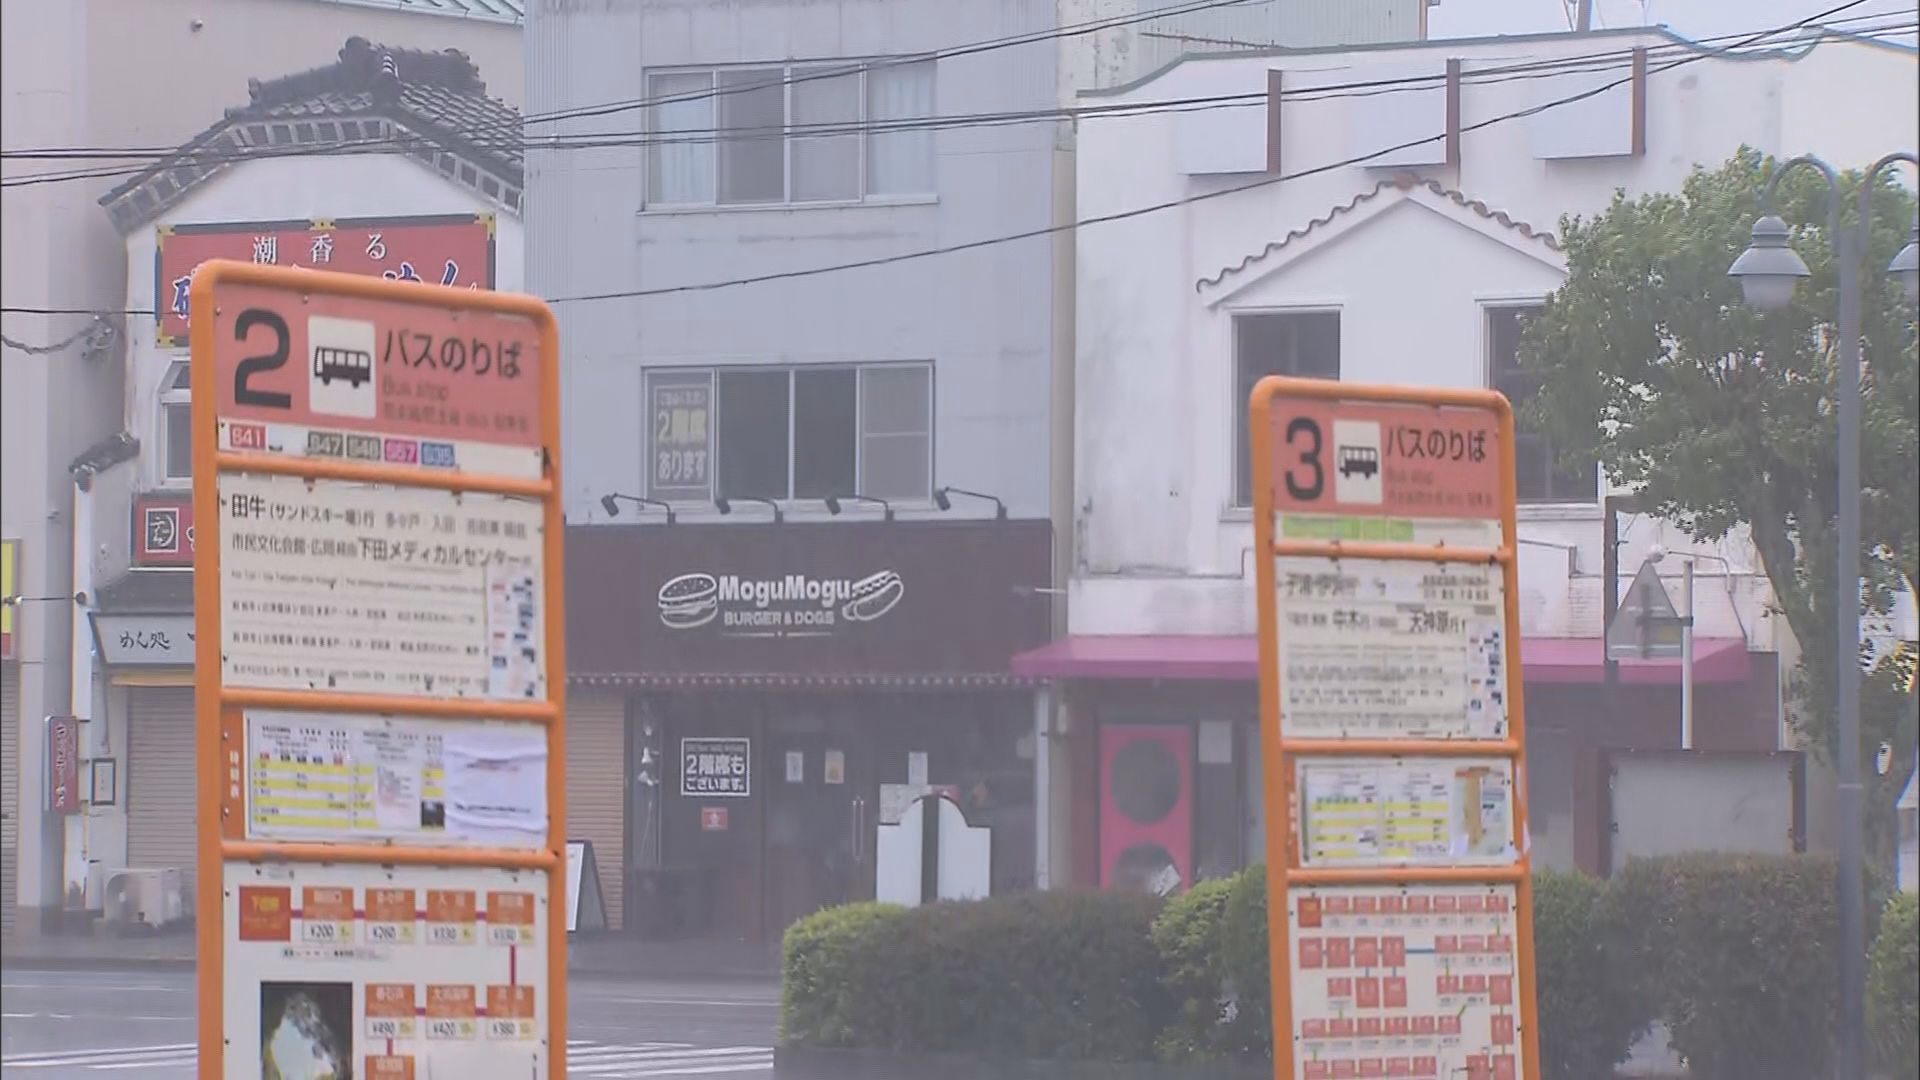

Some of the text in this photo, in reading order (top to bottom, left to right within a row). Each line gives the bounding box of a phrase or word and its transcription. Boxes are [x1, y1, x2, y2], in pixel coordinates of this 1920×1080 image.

[253, 234, 386, 264] 潮香る
[234, 308, 292, 410] 2
[384, 329, 522, 379] バスのりば
[1284, 417, 1324, 500] 3
[1386, 425, 1487, 463] バスのりば
[658, 449, 706, 481] あります
[718, 575, 850, 608] MoguMogu
[724, 611, 835, 626] BURGER & DOGS
[119, 631, 171, 651] めん処
